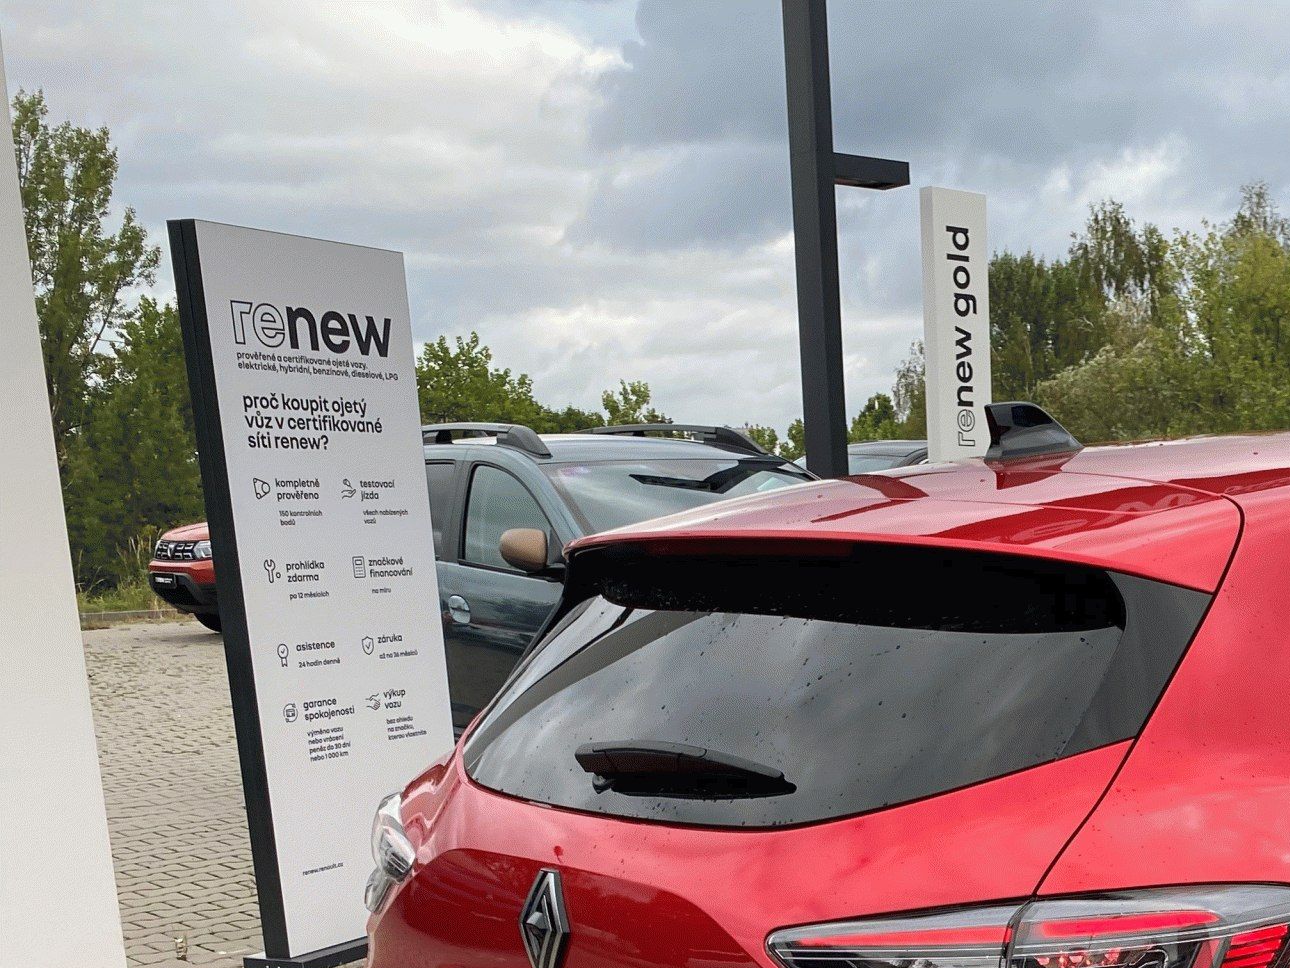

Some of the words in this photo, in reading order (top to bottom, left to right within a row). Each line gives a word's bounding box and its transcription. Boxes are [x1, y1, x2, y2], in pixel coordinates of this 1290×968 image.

[945, 225, 977, 317] gold
[230, 300, 391, 358] renew
[236, 351, 276, 362] prověřené
[282, 355, 331, 366] certifikované
[332, 358, 350, 369] ojeté
[238, 362, 278, 373] elektrické,
[385, 371, 399, 381] LPG
[954, 326, 976, 447] renew
[243, 393, 279, 412] proč
[282, 394, 329, 415] koupit
[332, 396, 366, 418] ojetý
[245, 410, 273, 429] vůz
[275, 416, 284, 429] v
[287, 415, 382, 433] certifikované
[248, 431, 271, 448] síti
[274, 434, 329, 450] renew?
[275, 478, 320, 490] kompletně
[360, 479, 395, 488] testovací
[277, 491, 319, 502] prověřeno
[361, 491, 379, 502] jízda
[286, 560, 325, 572] prohlídka
[368, 556, 403, 566] značkové
[287, 572, 319, 582] zdarma
[369, 567, 413, 578] financování
[377, 634, 403, 643] záruka
[296, 640, 335, 652] asistence
[306, 659, 323, 667] hodin
[383, 688, 406, 699] výkup
[303, 697, 337, 711] garance
[384, 700, 402, 709] vozu
[304, 705, 355, 721] spokojenosti
